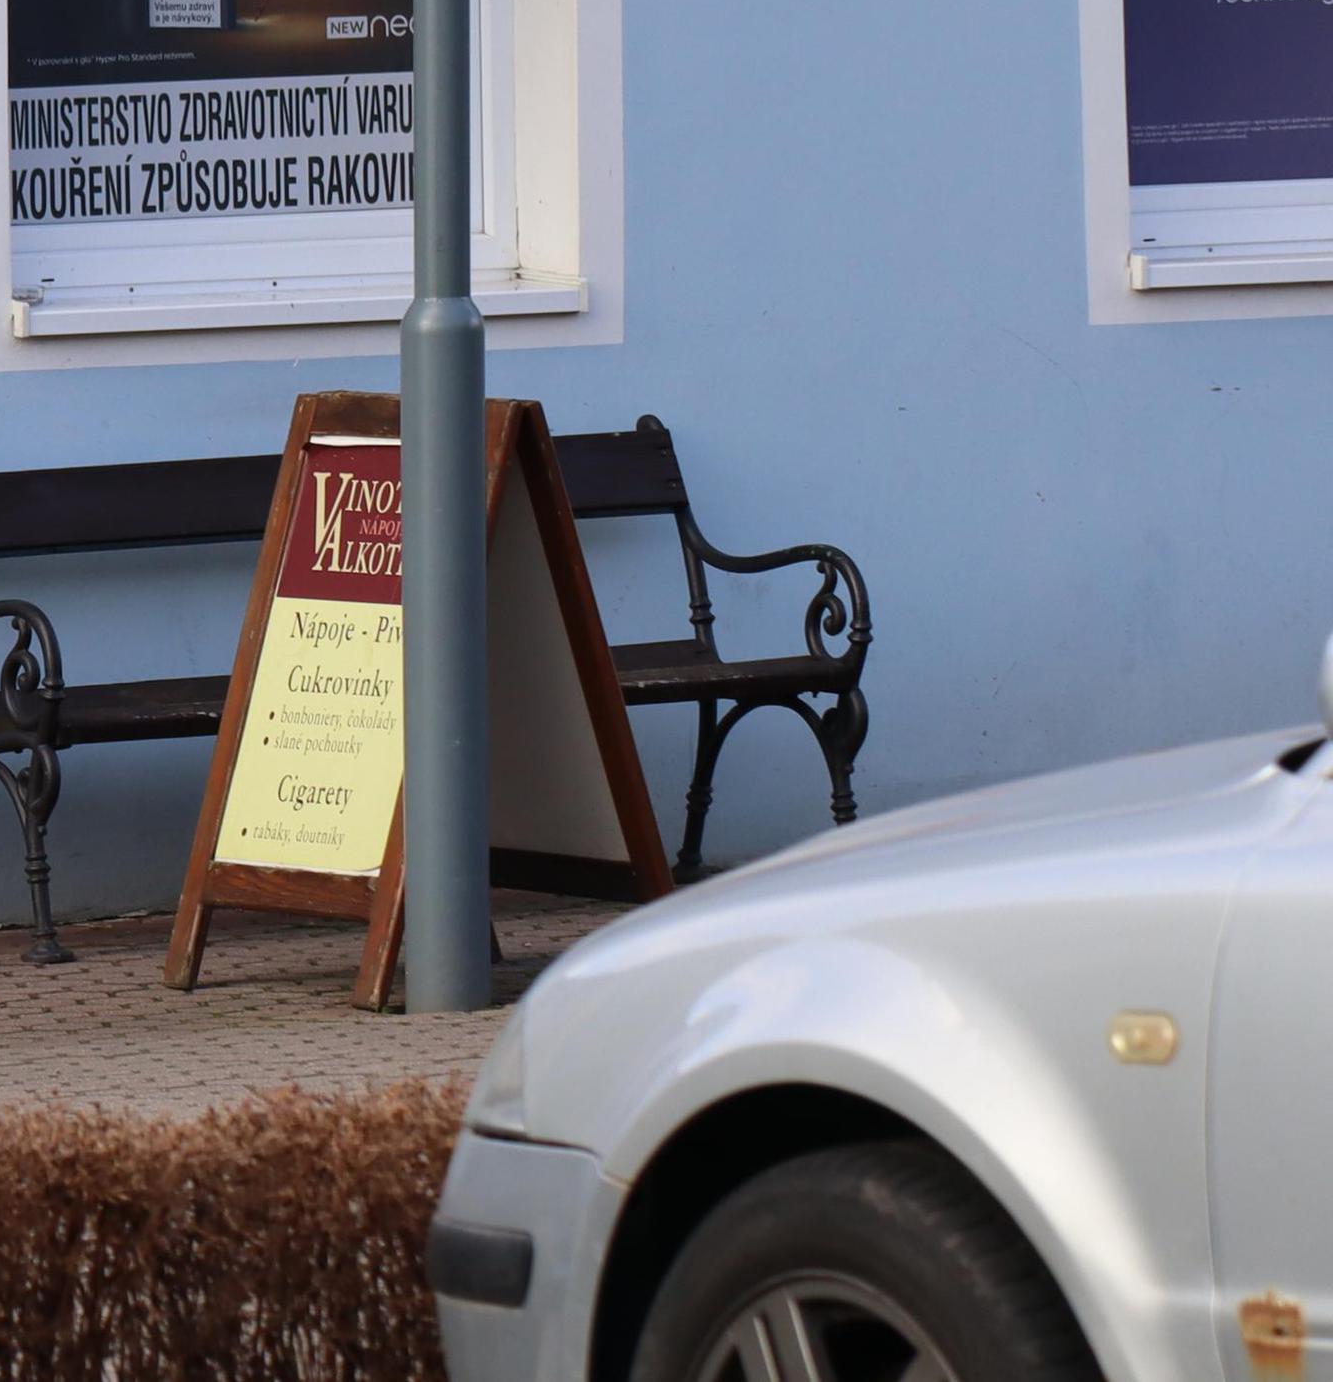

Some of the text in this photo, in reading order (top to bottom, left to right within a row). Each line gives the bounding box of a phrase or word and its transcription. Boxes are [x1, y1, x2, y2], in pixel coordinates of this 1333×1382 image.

[154, 0, 215, 13] Vašemu zdraví
[162, 13, 169, 25] je
[330, 21, 365, 35] NEW
[10, 77, 413, 150] MINISTERSTVO ZDRAVOTNICTVÍ VARU
[12, 154, 132, 221] KOUŘENÍ
[141, 149, 298, 214] ZPŮSOBUJE
[311, 508, 402, 576] ALKOT
[359, 515, 402, 541] NÁPOJ
[290, 611, 403, 650] Nápoje Piv
[287, 664, 394, 704] Cukrovinky
[280, 704, 396, 735] bonboniery, čokolády
[274, 731, 363, 759] slané pochoutky
[278, 774, 353, 815] Cigarety
[253, 822, 346, 850] tabáky, doutníky
